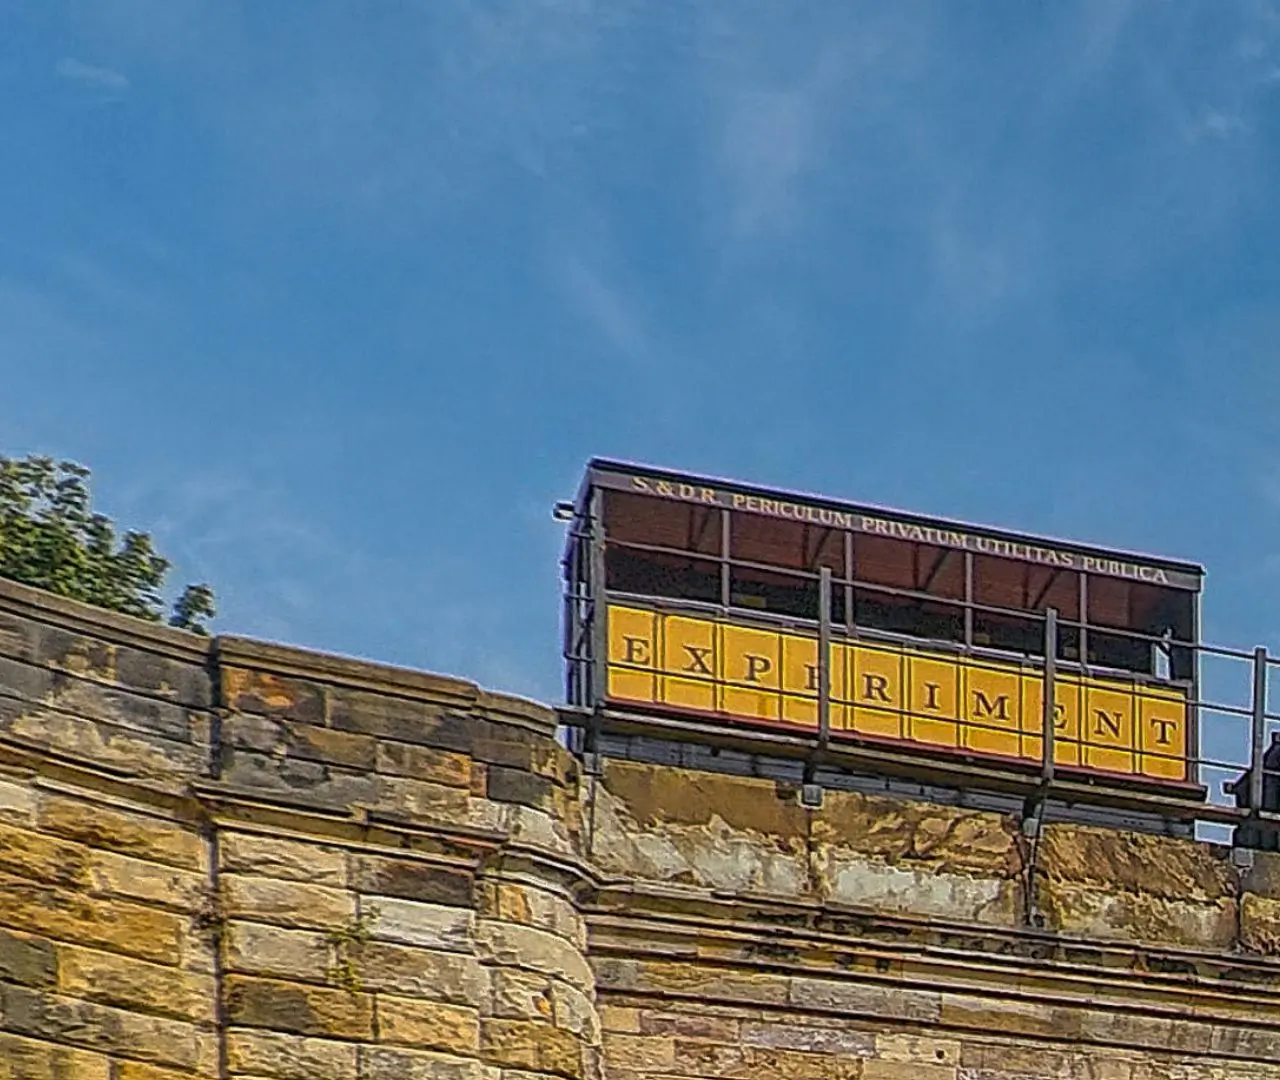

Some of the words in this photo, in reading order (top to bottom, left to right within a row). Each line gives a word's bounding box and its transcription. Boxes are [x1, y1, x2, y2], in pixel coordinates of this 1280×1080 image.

[732, 493, 851, 528] PERICULUM
[861, 516, 967, 549] PRIVATUM
[976, 537, 1074, 567] UTILITAS
[1081, 555, 1169, 584] PUBLICA
